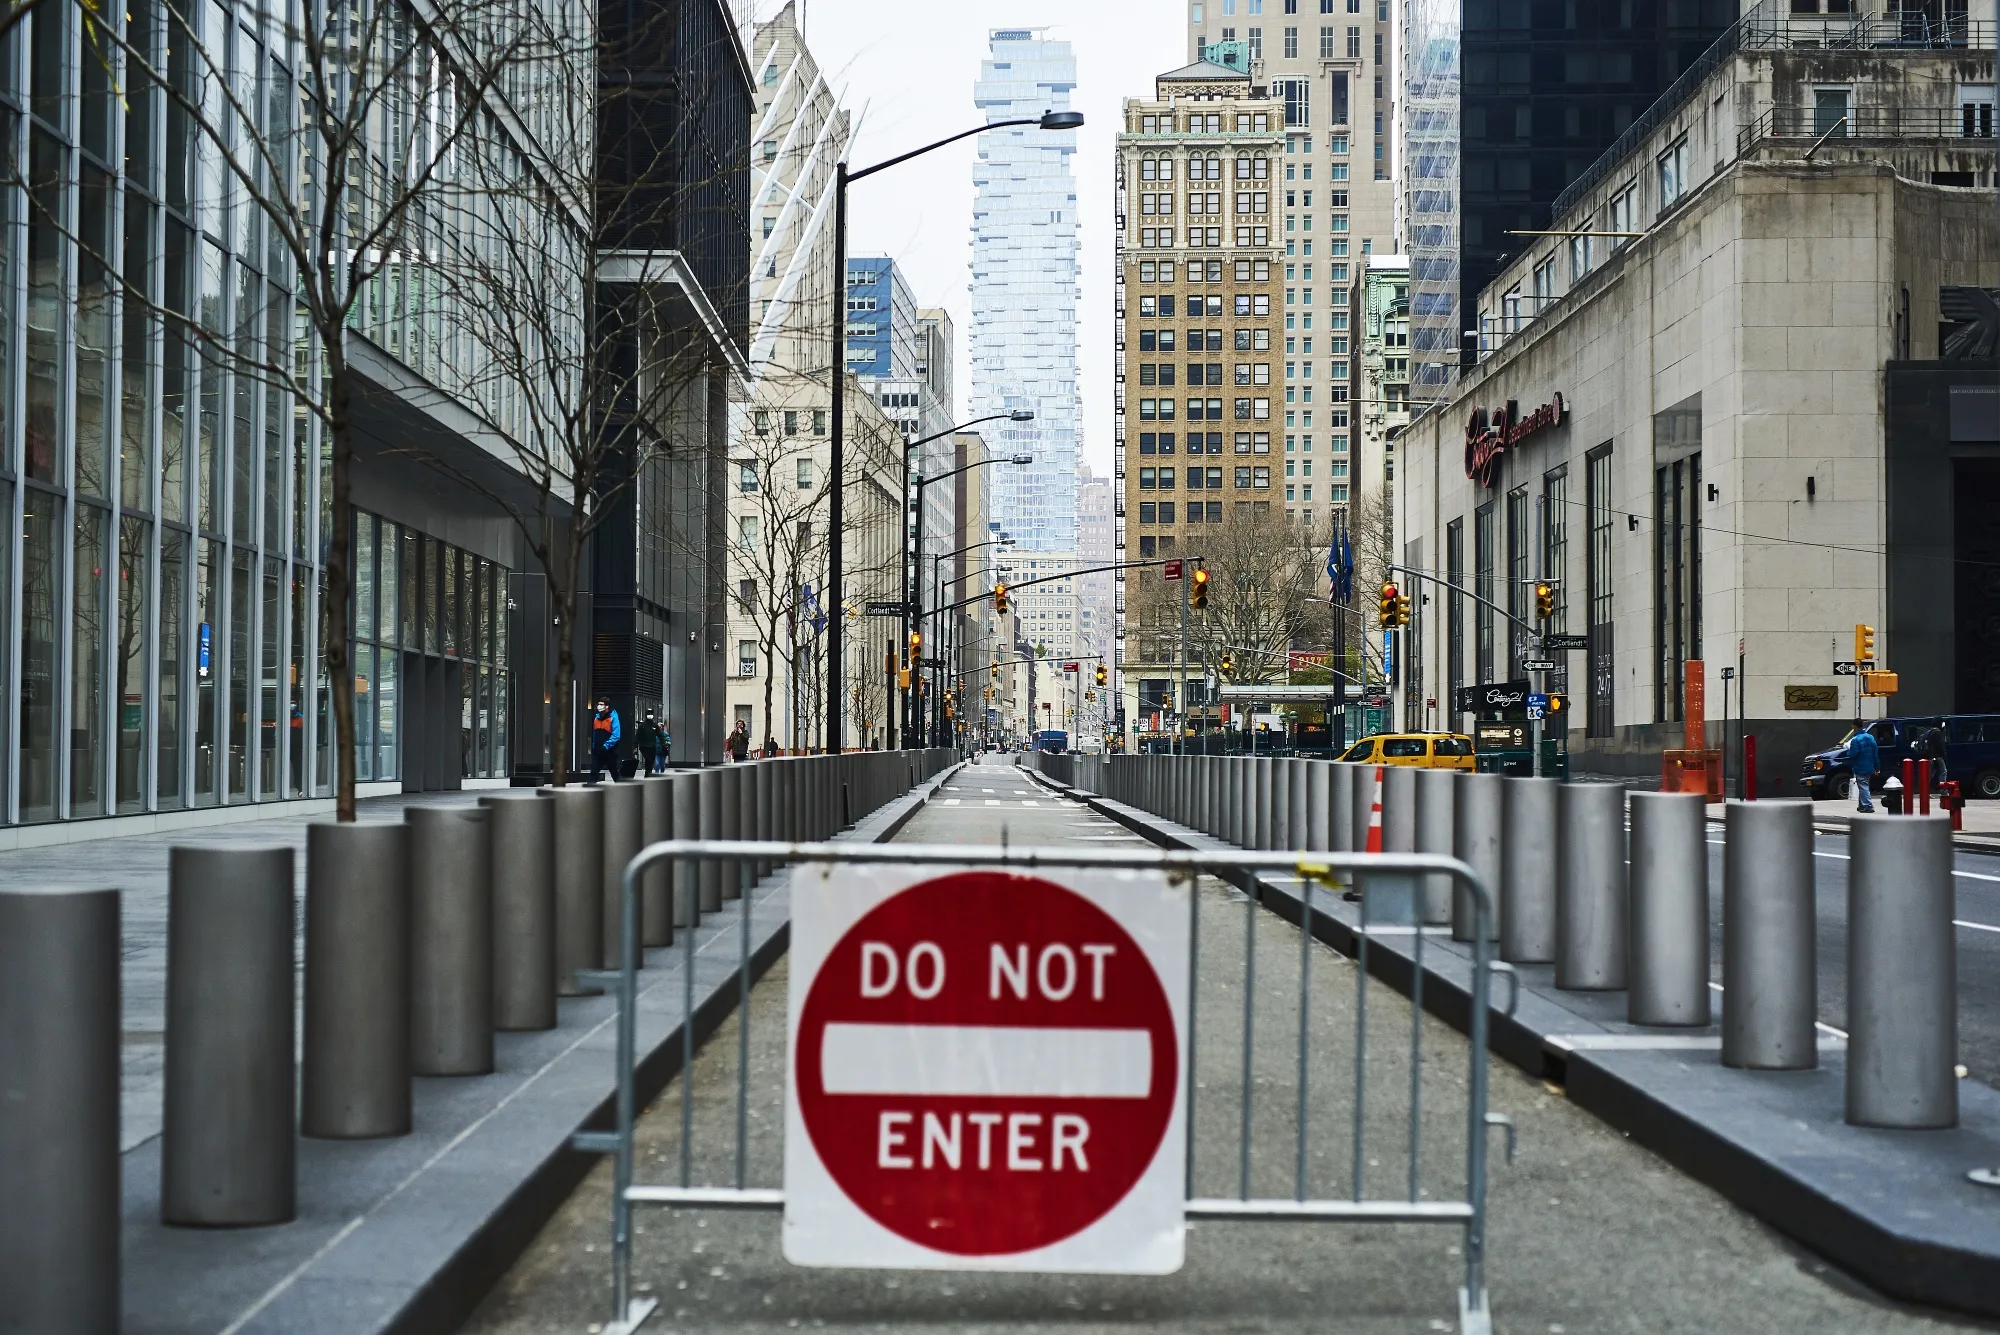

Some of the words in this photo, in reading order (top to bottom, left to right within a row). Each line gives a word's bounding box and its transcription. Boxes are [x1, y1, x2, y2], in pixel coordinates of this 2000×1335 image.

[867, 607, 890, 615] Cortlandt
[1558, 639, 1583, 647] Cortlandt
[1486, 689, 1511, 707] Century
[1787, 689, 1821, 707] Century
[859, 941, 946, 999] DO
[989, 943, 1117, 1001] NOT
[877, 1110, 1091, 1171] ENTER
